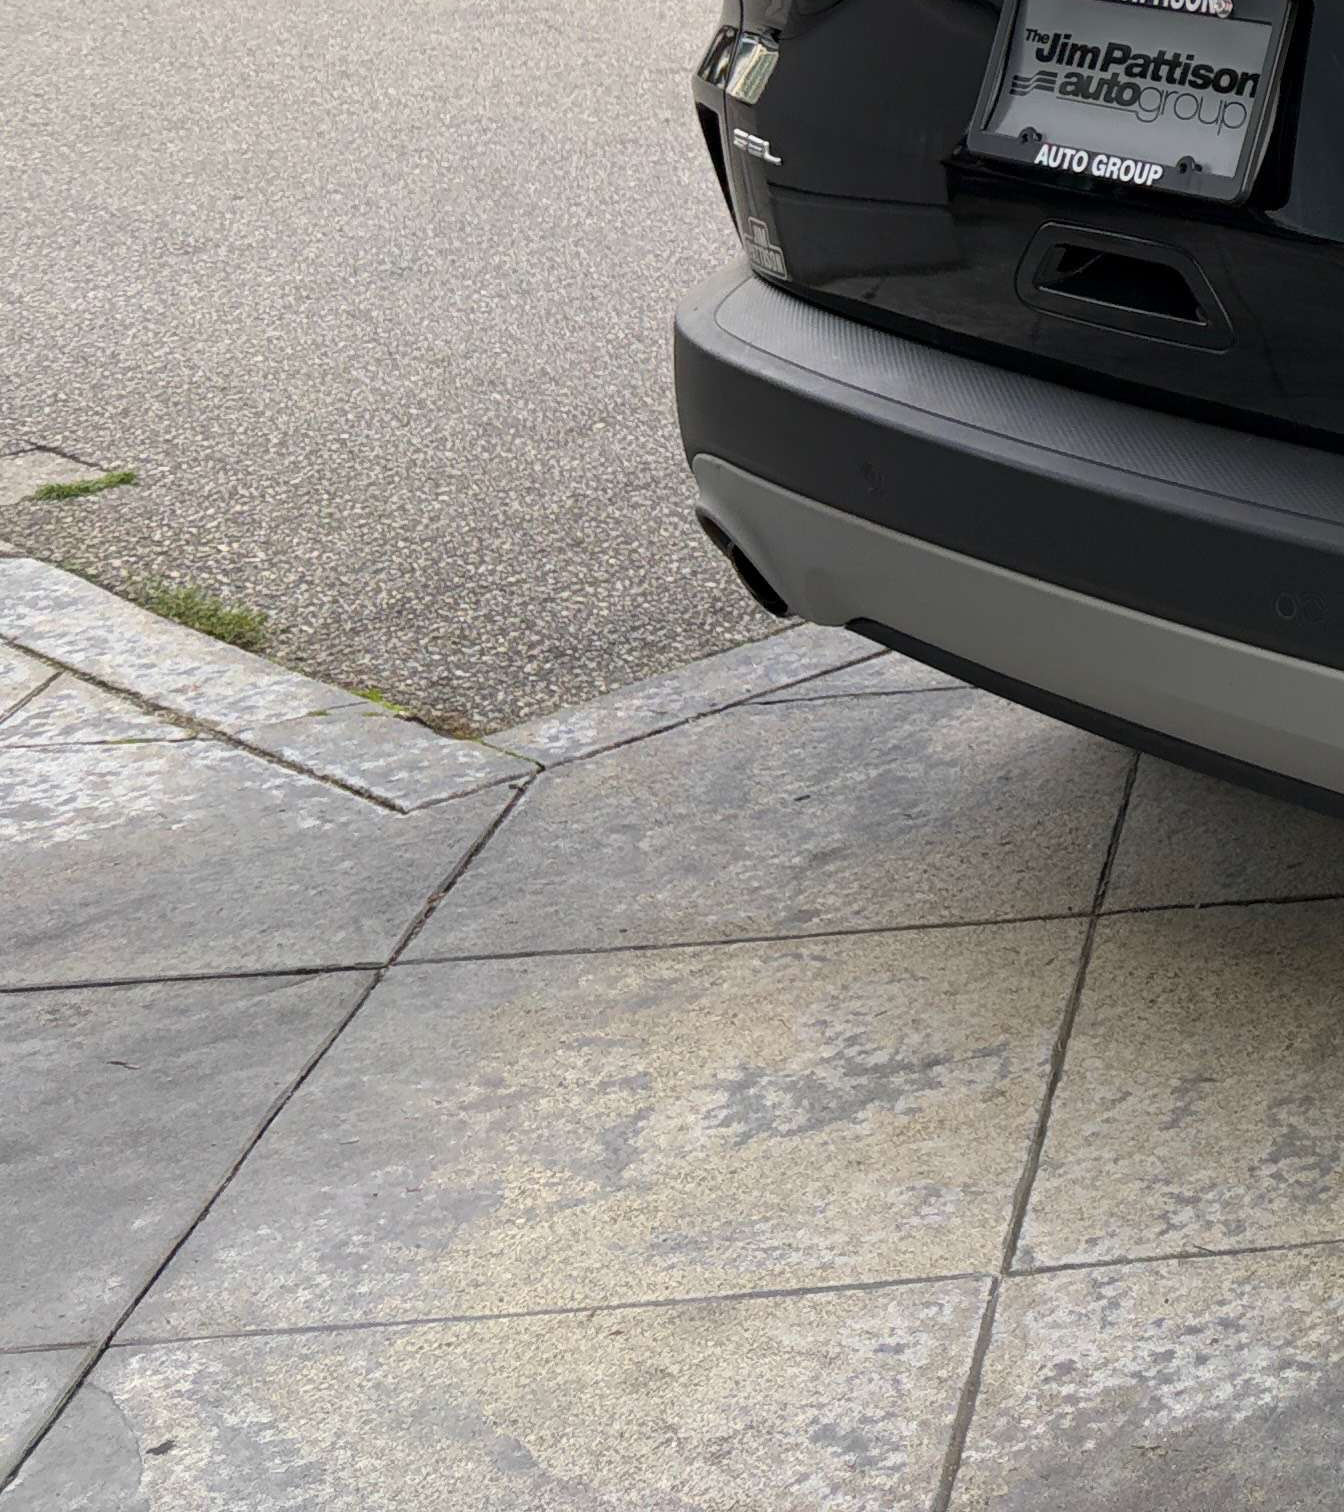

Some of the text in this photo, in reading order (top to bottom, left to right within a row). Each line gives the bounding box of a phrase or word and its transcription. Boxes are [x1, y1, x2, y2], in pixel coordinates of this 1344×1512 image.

[1025, 28, 1050, 45] The
[1034, 143, 1164, 187] AUTO GROUP
